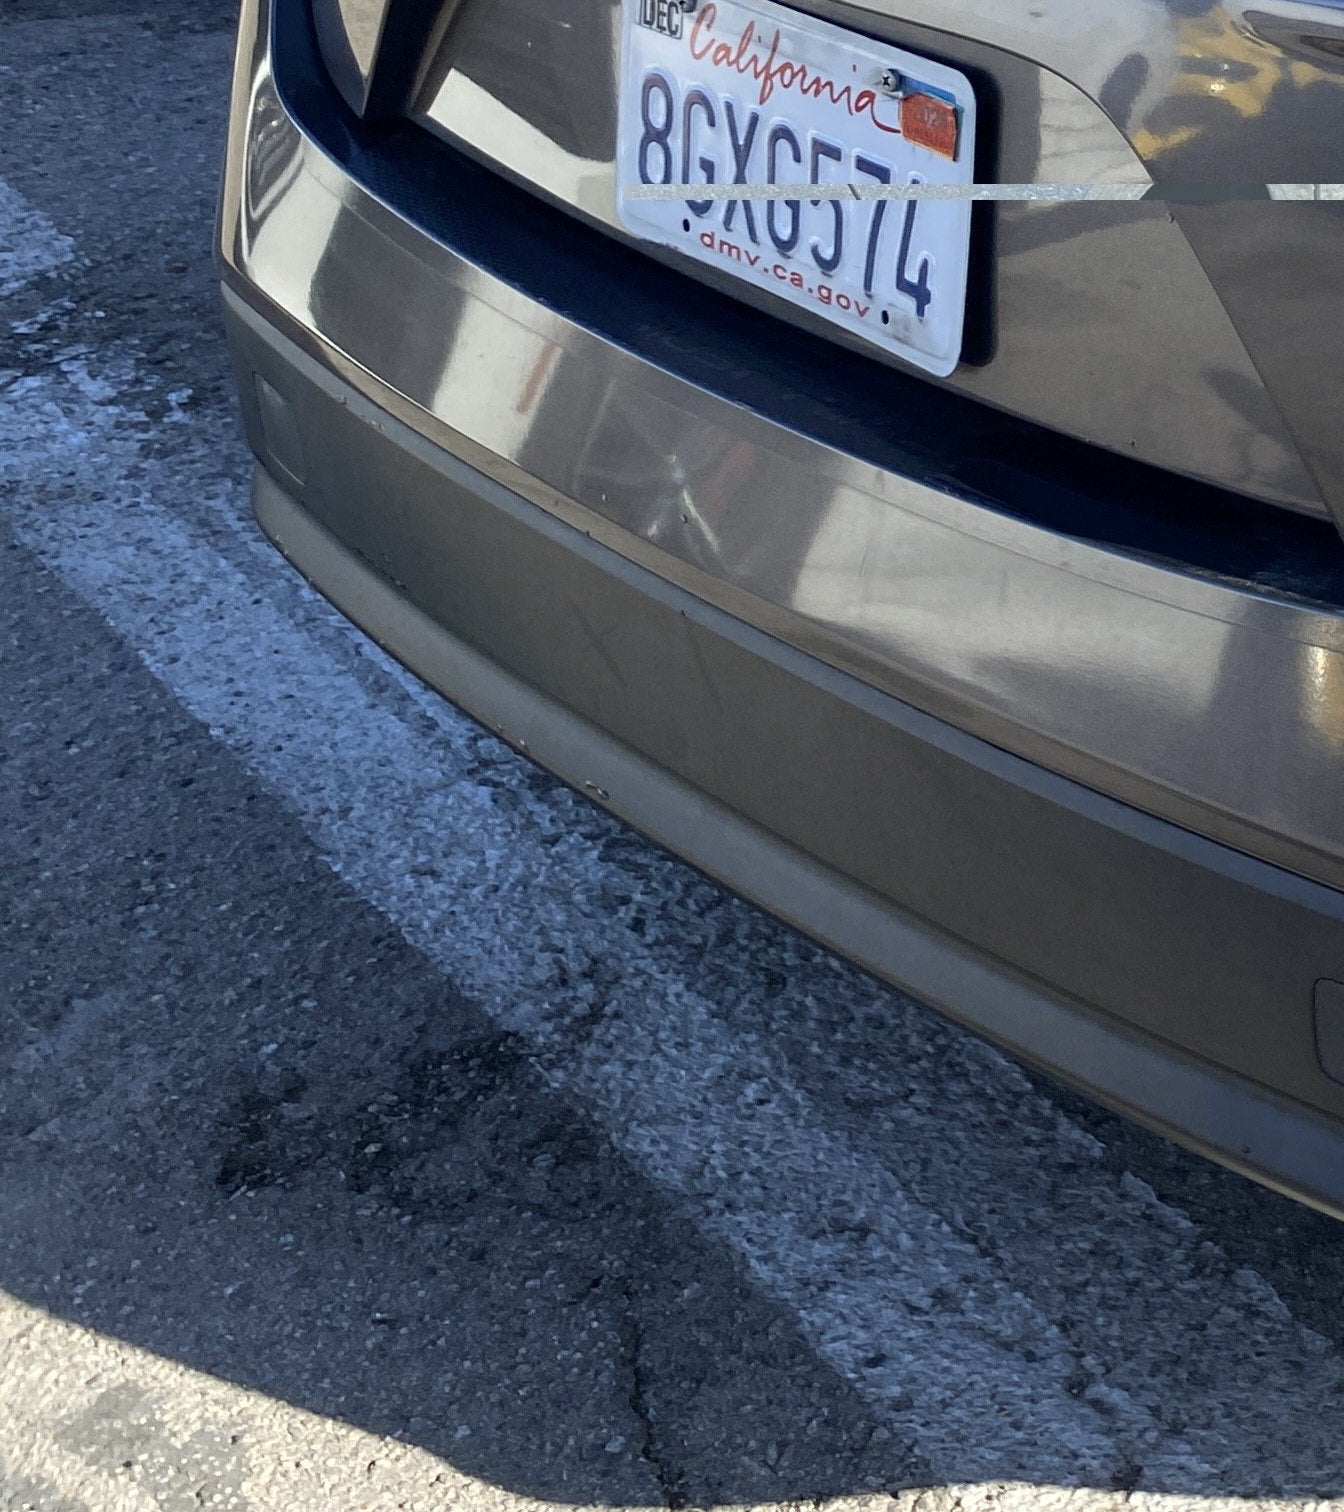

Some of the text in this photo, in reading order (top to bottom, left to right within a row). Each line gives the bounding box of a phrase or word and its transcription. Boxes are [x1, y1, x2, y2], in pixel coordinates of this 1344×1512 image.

[689, 2, 901, 134] California
[639, 72, 932, 319] 8GXG574
[699, 230, 870, 318] dmv.ca.gov
